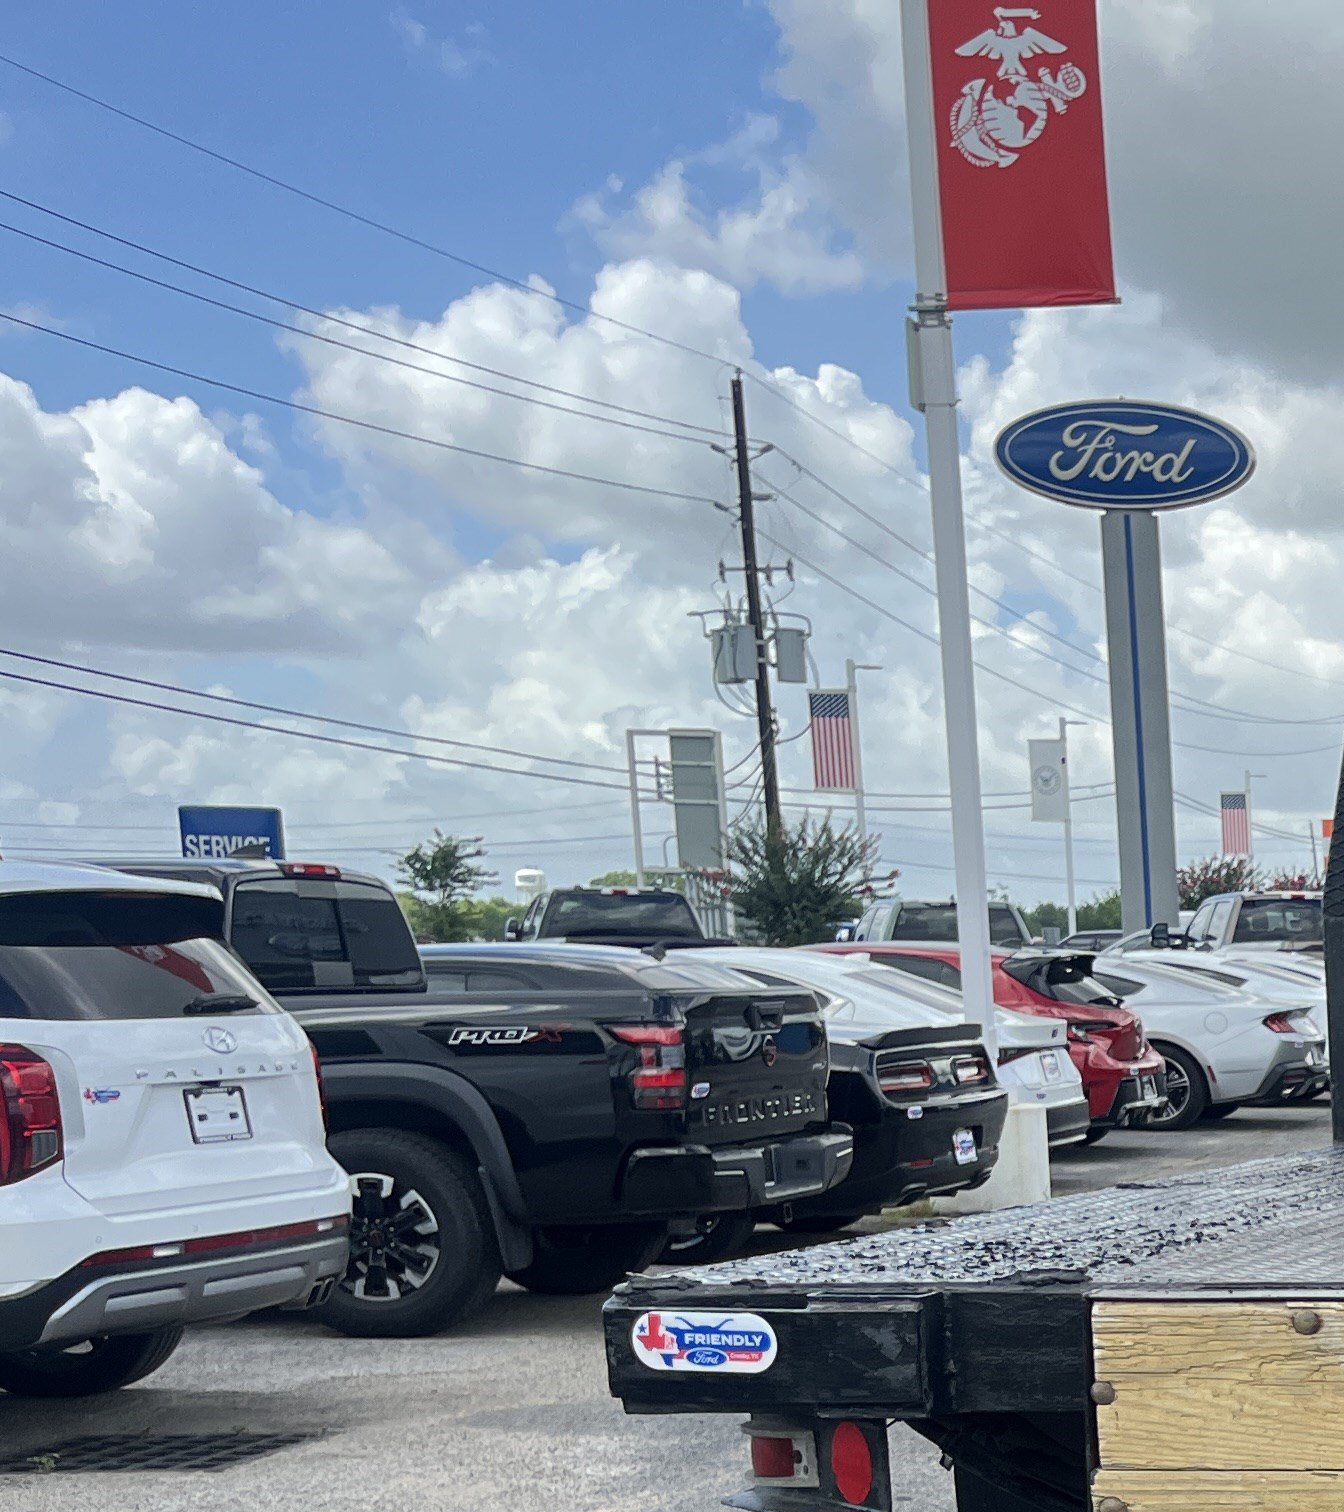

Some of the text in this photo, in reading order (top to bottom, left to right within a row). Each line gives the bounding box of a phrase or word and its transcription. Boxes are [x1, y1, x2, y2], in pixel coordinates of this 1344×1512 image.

[1048, 420, 1198, 484] Ford
[135, 1062, 299, 1080] PALISADE
[702, 1093, 816, 1127] FRONTIER
[684, 1332, 764, 1347] FRIENDLY
[693, 1350, 719, 1365] Ford
